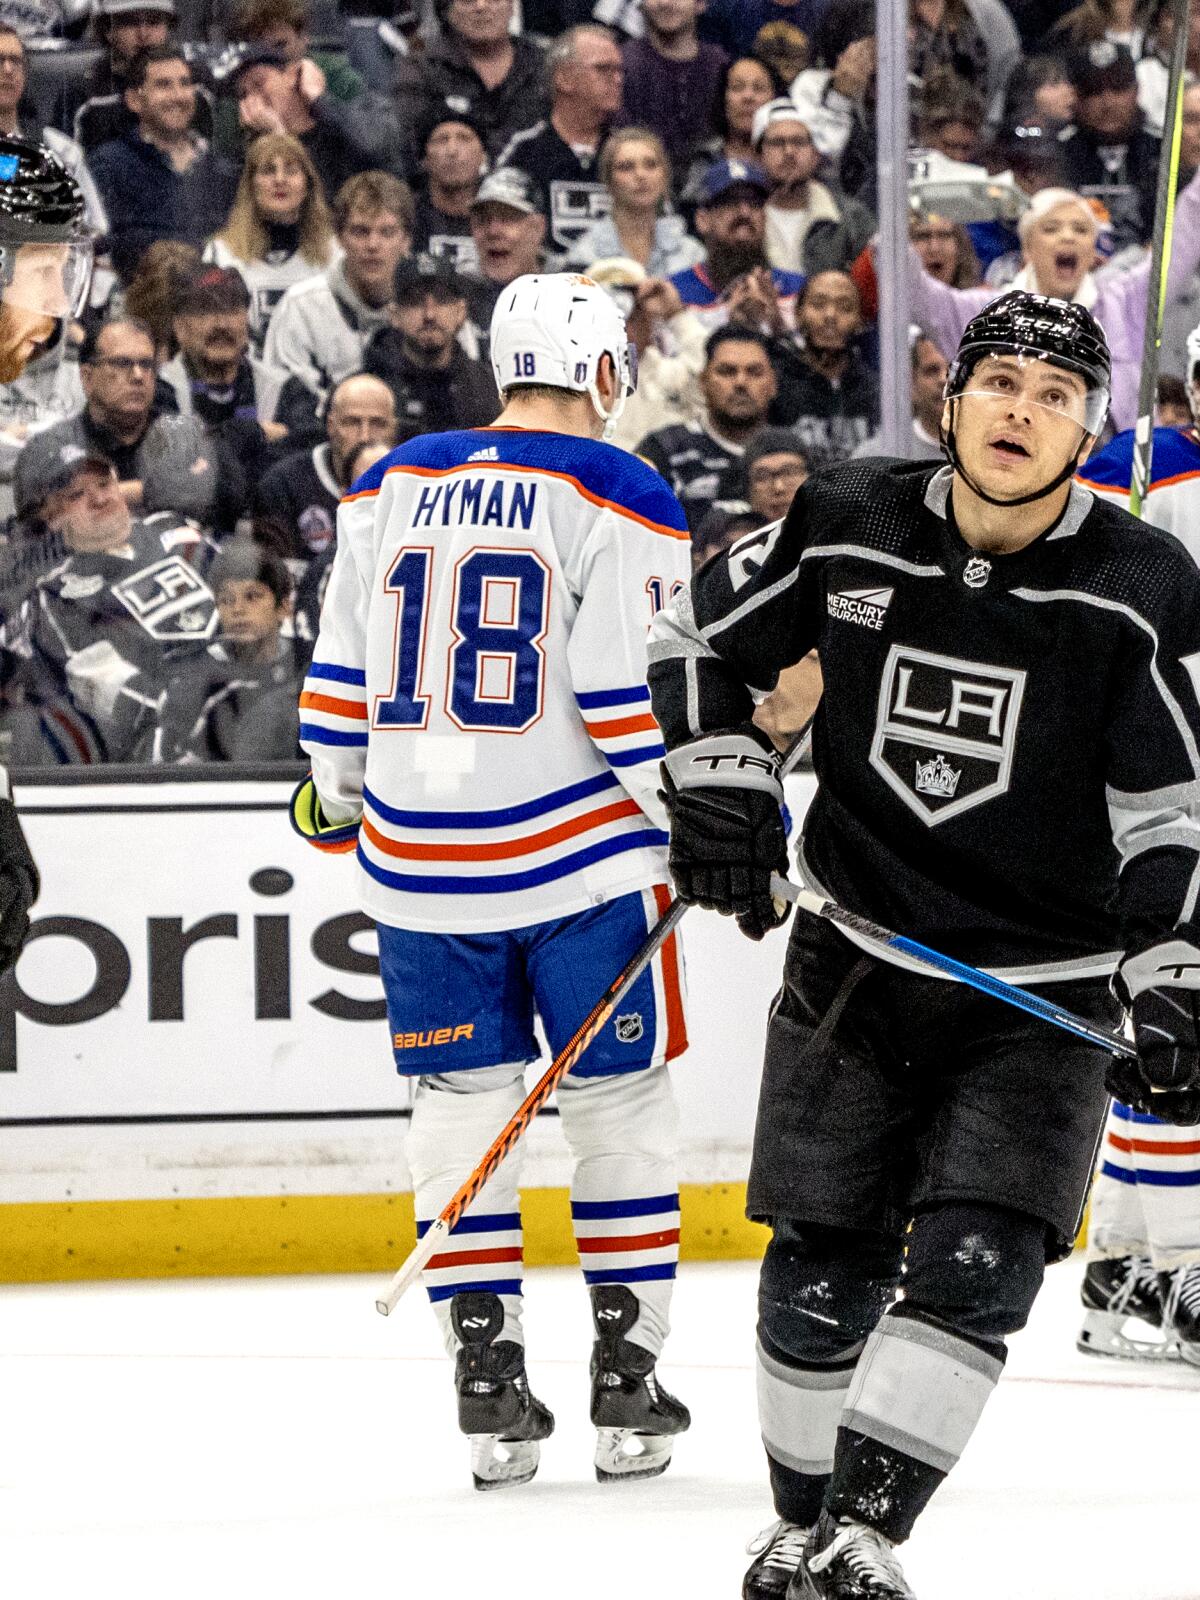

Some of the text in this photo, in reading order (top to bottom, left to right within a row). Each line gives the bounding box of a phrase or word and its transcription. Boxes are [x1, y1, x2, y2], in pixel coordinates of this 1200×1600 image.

[1014, 315, 1072, 335] CCM
[514, 352, 535, 377] 18
[412, 478, 537, 530] HYMAN
[124, 563, 201, 613] LA
[827, 592, 886, 620] MERCURY
[372, 546, 552, 734] 18
[892, 666, 1008, 737] LA
